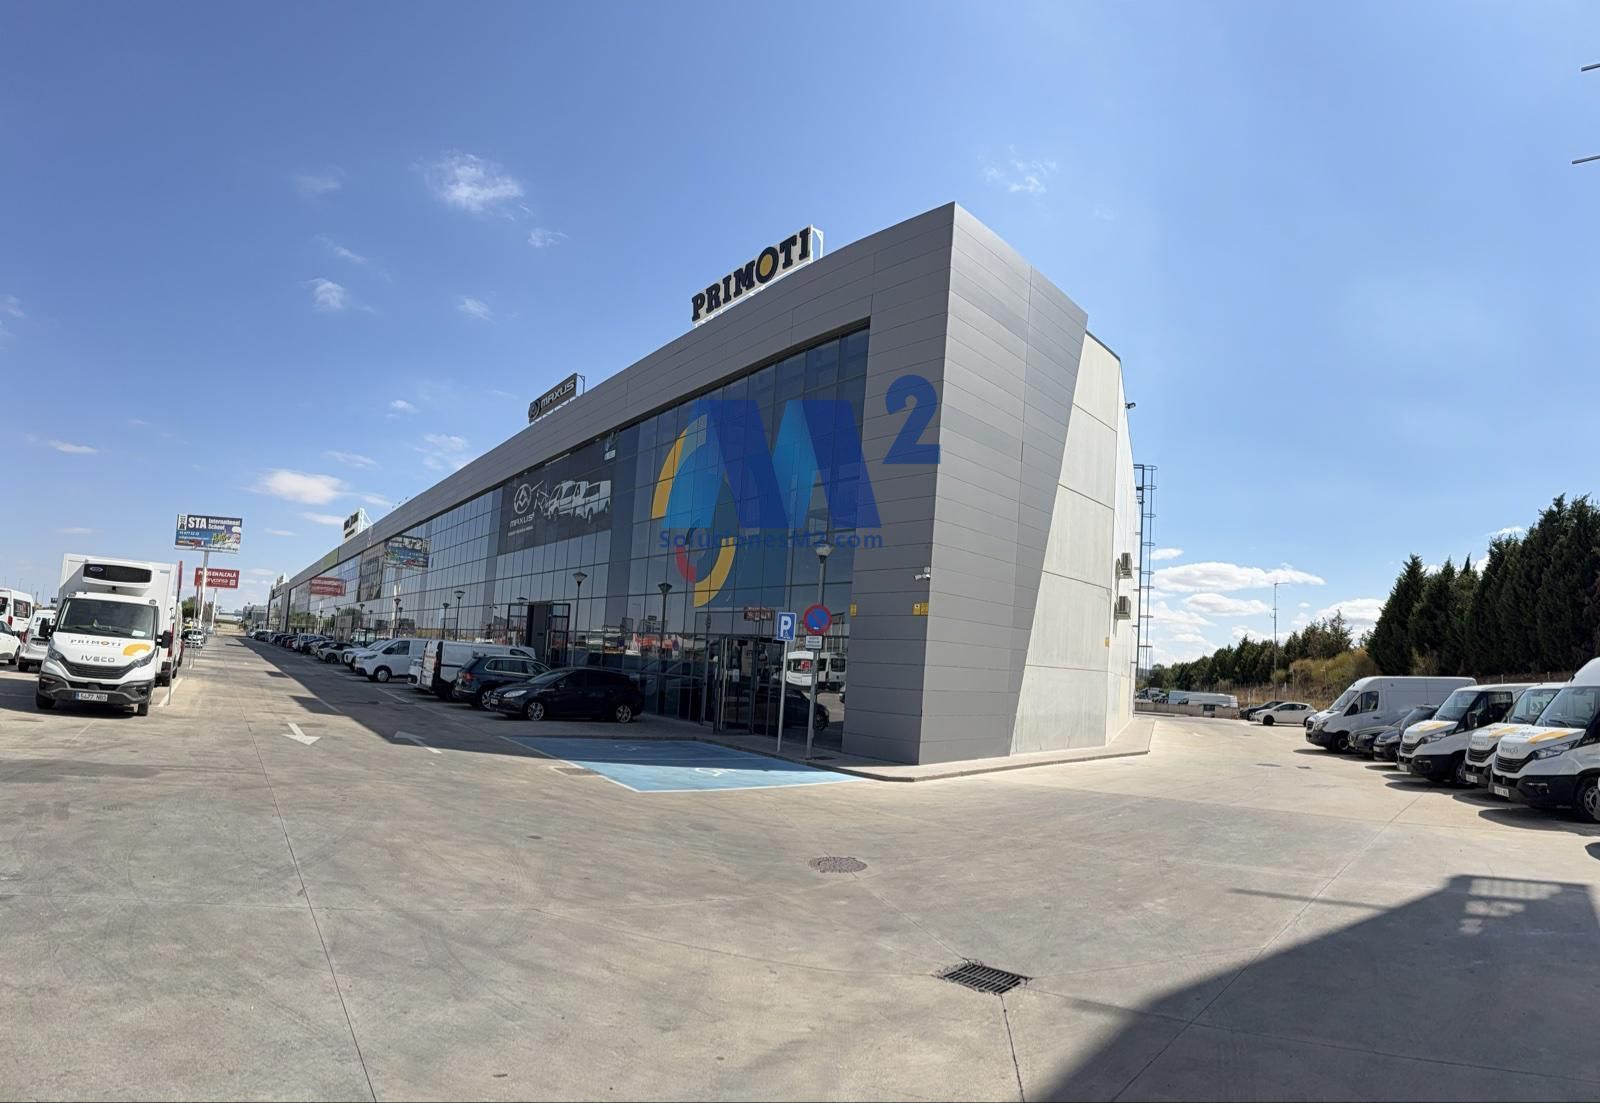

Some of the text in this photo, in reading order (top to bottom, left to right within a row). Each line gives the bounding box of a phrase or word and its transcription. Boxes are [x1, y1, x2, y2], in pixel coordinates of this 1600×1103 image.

[692, 227, 810, 321] PRIMOTI
[541, 380, 575, 408] MAXUS
[188, 517, 207, 529] STA
[780, 614, 792, 638] P
[70, 639, 121, 647] PRIMOTI
[80, 655, 116, 663] IVECO
